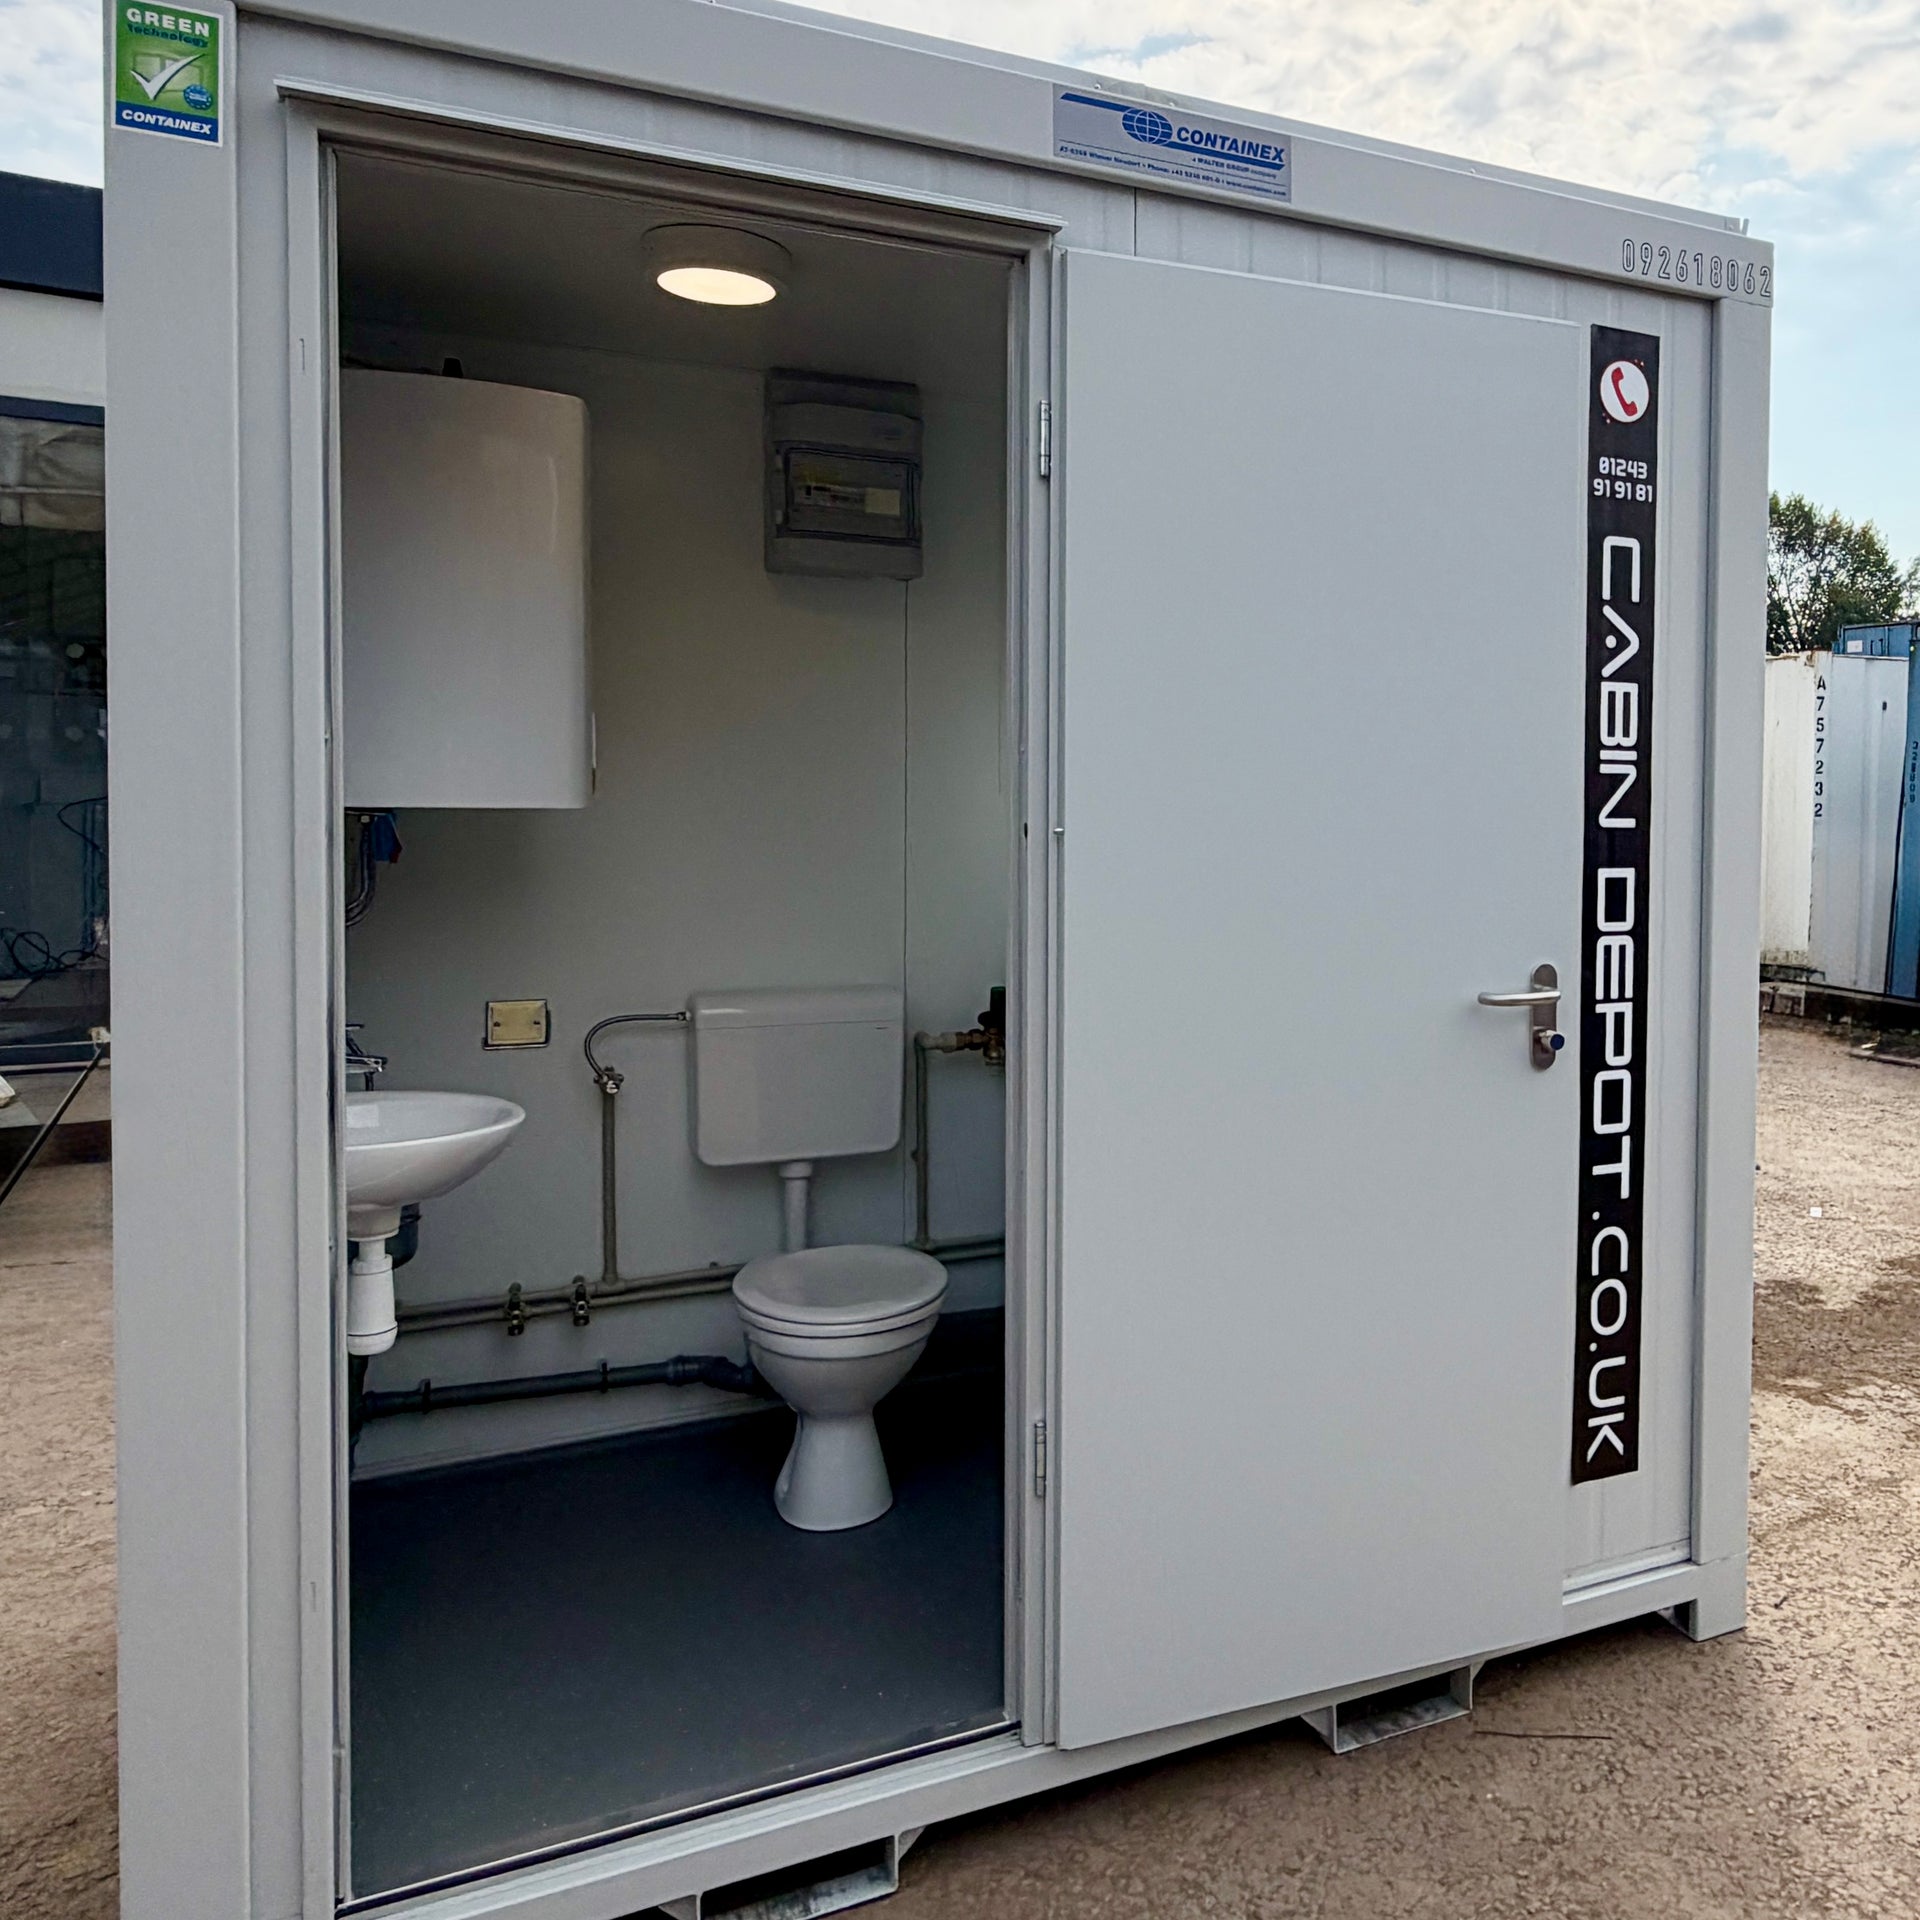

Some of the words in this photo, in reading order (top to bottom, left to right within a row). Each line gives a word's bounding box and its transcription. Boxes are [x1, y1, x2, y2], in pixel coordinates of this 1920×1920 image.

[126, 8, 210, 37] GREEN
[127, 23, 208, 48] technology
[122, 110, 212, 135] CONTAINEX
[1177, 126, 1286, 163] CONTAINEX
[1197, 158, 1225, 169] WALTER
[1622, 238, 1772, 298] 092618062
[1599, 456, 1648, 480] 01243
[1598, 535, 1641, 829] CABIN
